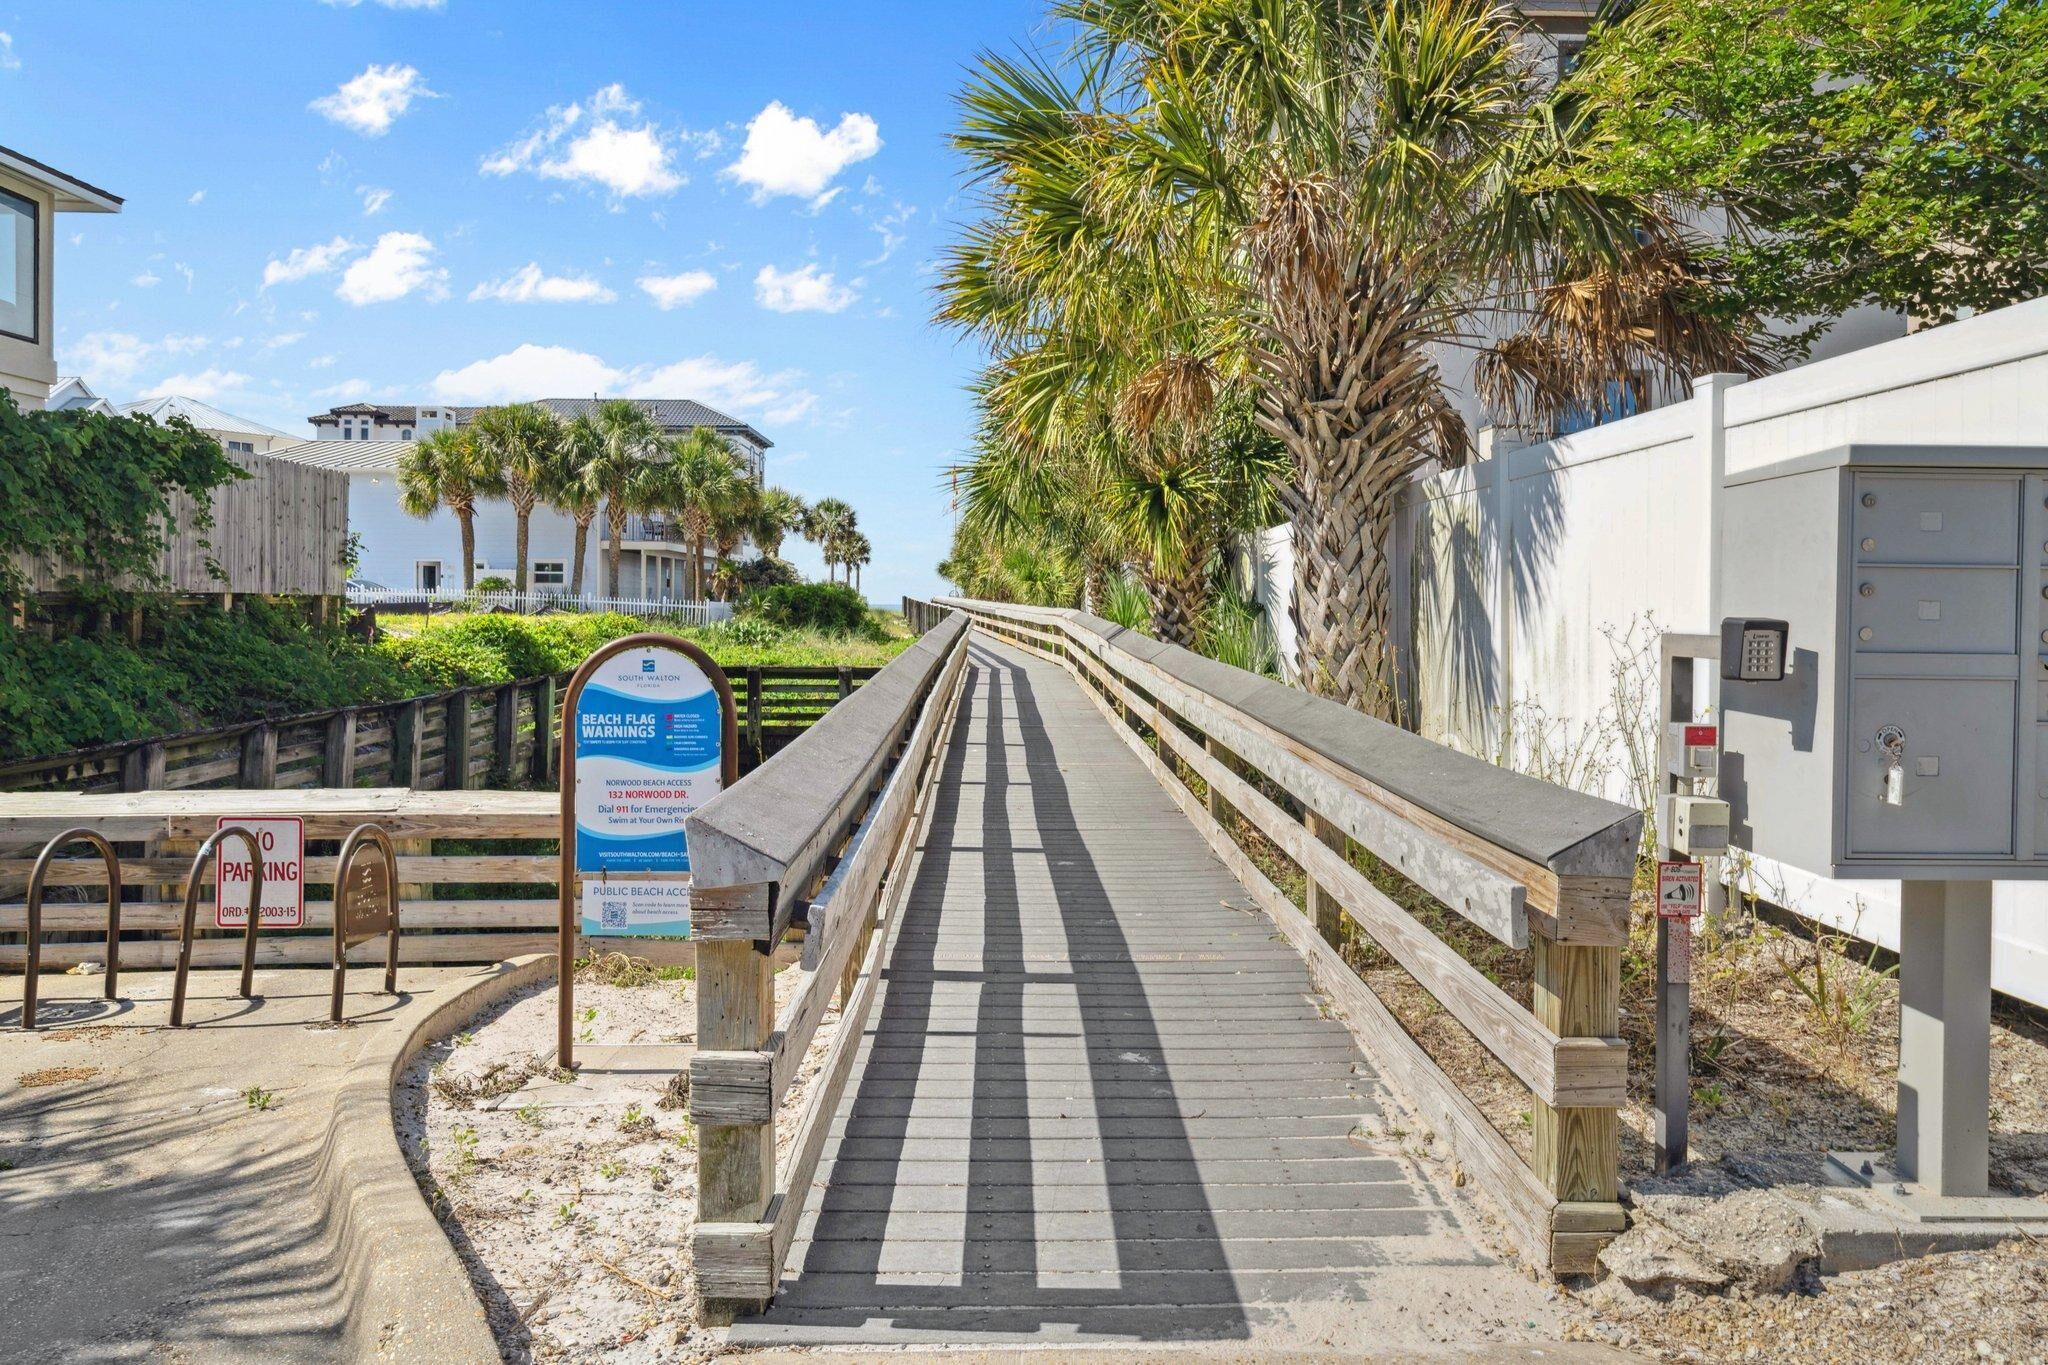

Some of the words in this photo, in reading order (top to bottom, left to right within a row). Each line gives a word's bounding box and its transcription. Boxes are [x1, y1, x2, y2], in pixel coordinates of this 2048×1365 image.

[582, 714, 622, 725] BEACH
[626, 714, 656, 725] FLAG
[582, 726, 656, 738] WARNINGS
[1882, 726, 1898, 734] OPEN
[606, 779, 641, 787] NORWOOD
[643, 779, 666, 787] BEACH
[667, 779, 692, 787] ACCESS
[608, 790, 623, 799] 132
[625, 790, 672, 799] NORWOOD
[674, 790, 689, 799] DR.
[598, 805, 614, 813] Dial
[616, 805, 629, 813] 911
[631, 805, 643, 813] for
[645, 805, 698, 815] Emergencie
[608, 816, 629, 824] Swim
[639, 816, 655, 824] Your
[656, 816, 673, 824] Own
[593, 886, 628, 896] PUBLIC
[631, 886, 663, 896] BEACH
